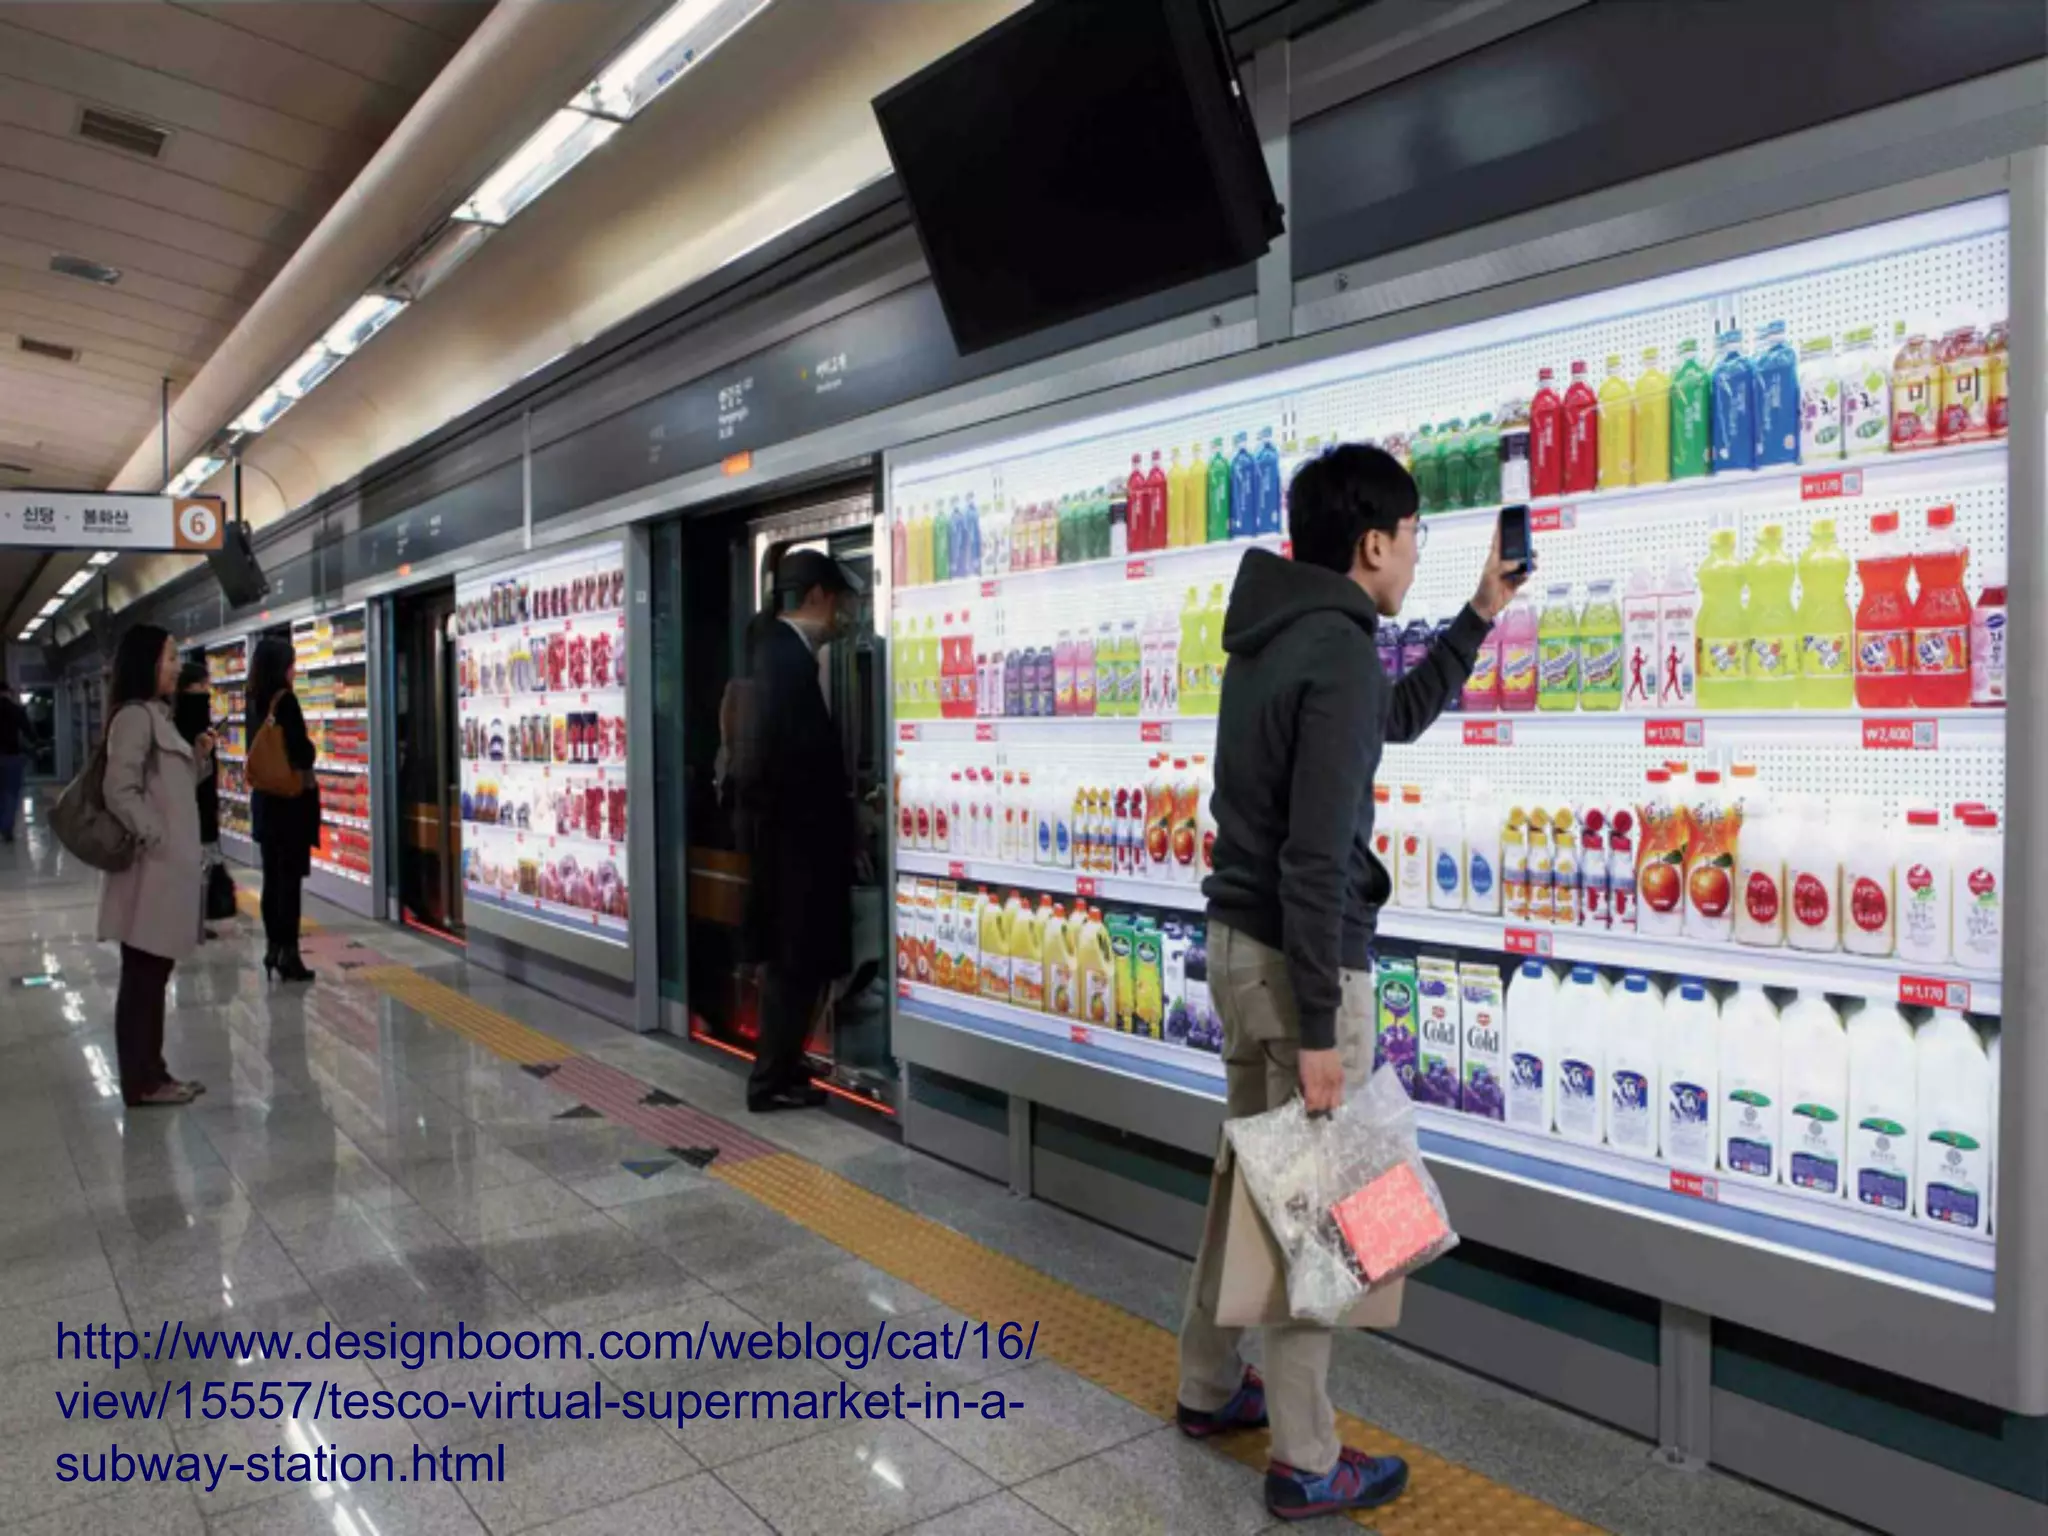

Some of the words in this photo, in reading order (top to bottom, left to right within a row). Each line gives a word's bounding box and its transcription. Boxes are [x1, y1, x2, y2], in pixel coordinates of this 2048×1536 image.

[22, 506, 55, 524] 신당
[190, 512, 206, 536] 6
[1422, 1018, 1457, 1047] Cold
[1466, 1025, 1500, 1054] Cold
